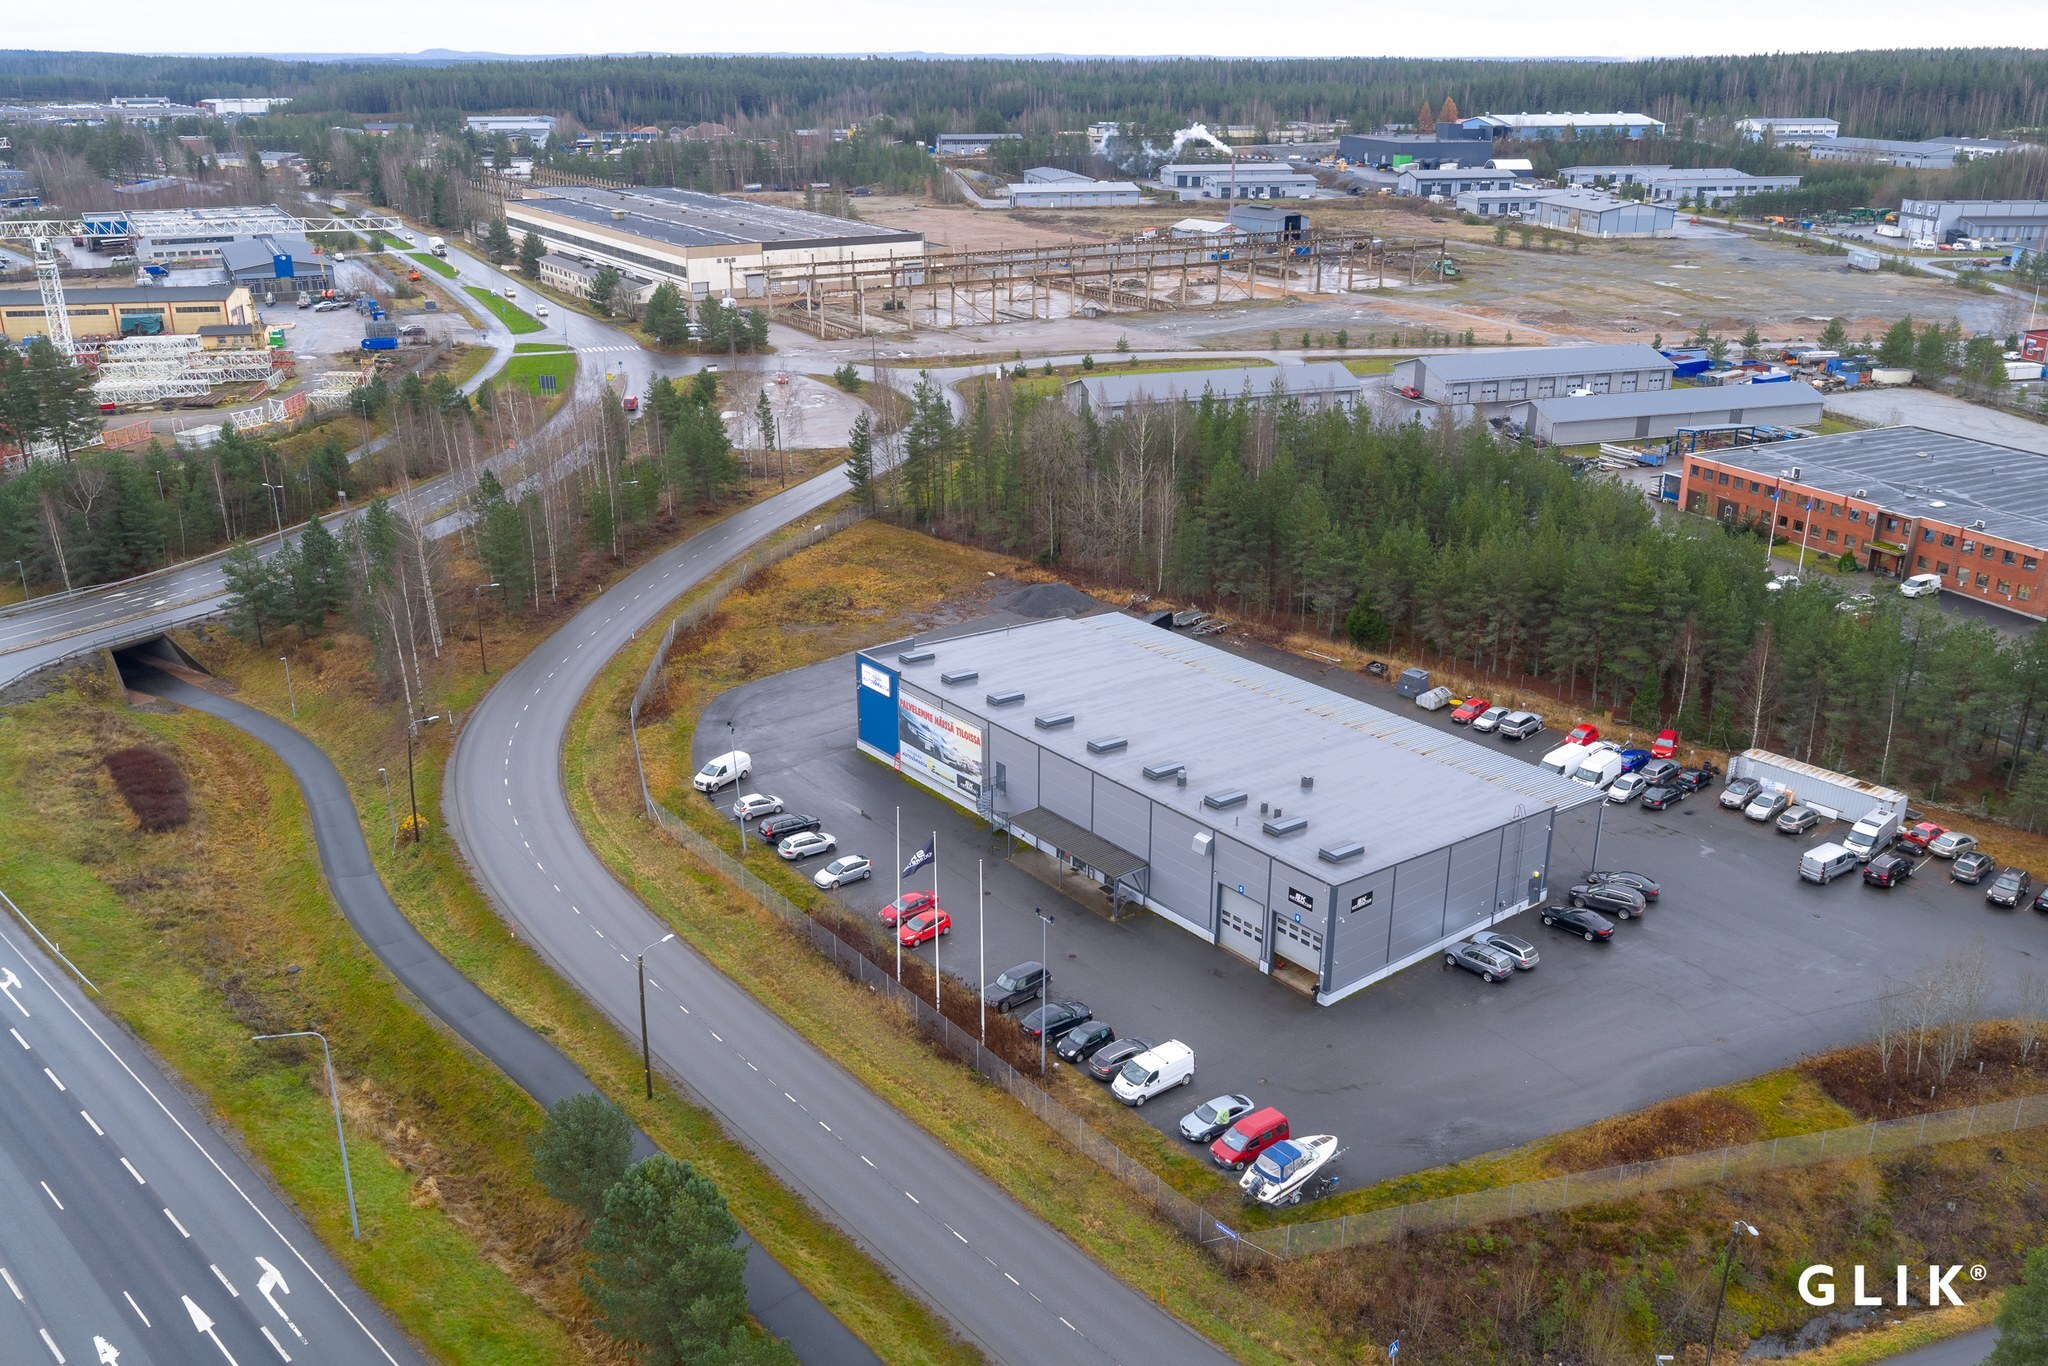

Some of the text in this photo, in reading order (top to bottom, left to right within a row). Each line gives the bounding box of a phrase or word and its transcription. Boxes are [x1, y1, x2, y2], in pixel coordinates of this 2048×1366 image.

[1901, 201, 1936, 217] MEP
[899, 698, 981, 746] PALVELEMME NÄISSÄ TILOISSA
